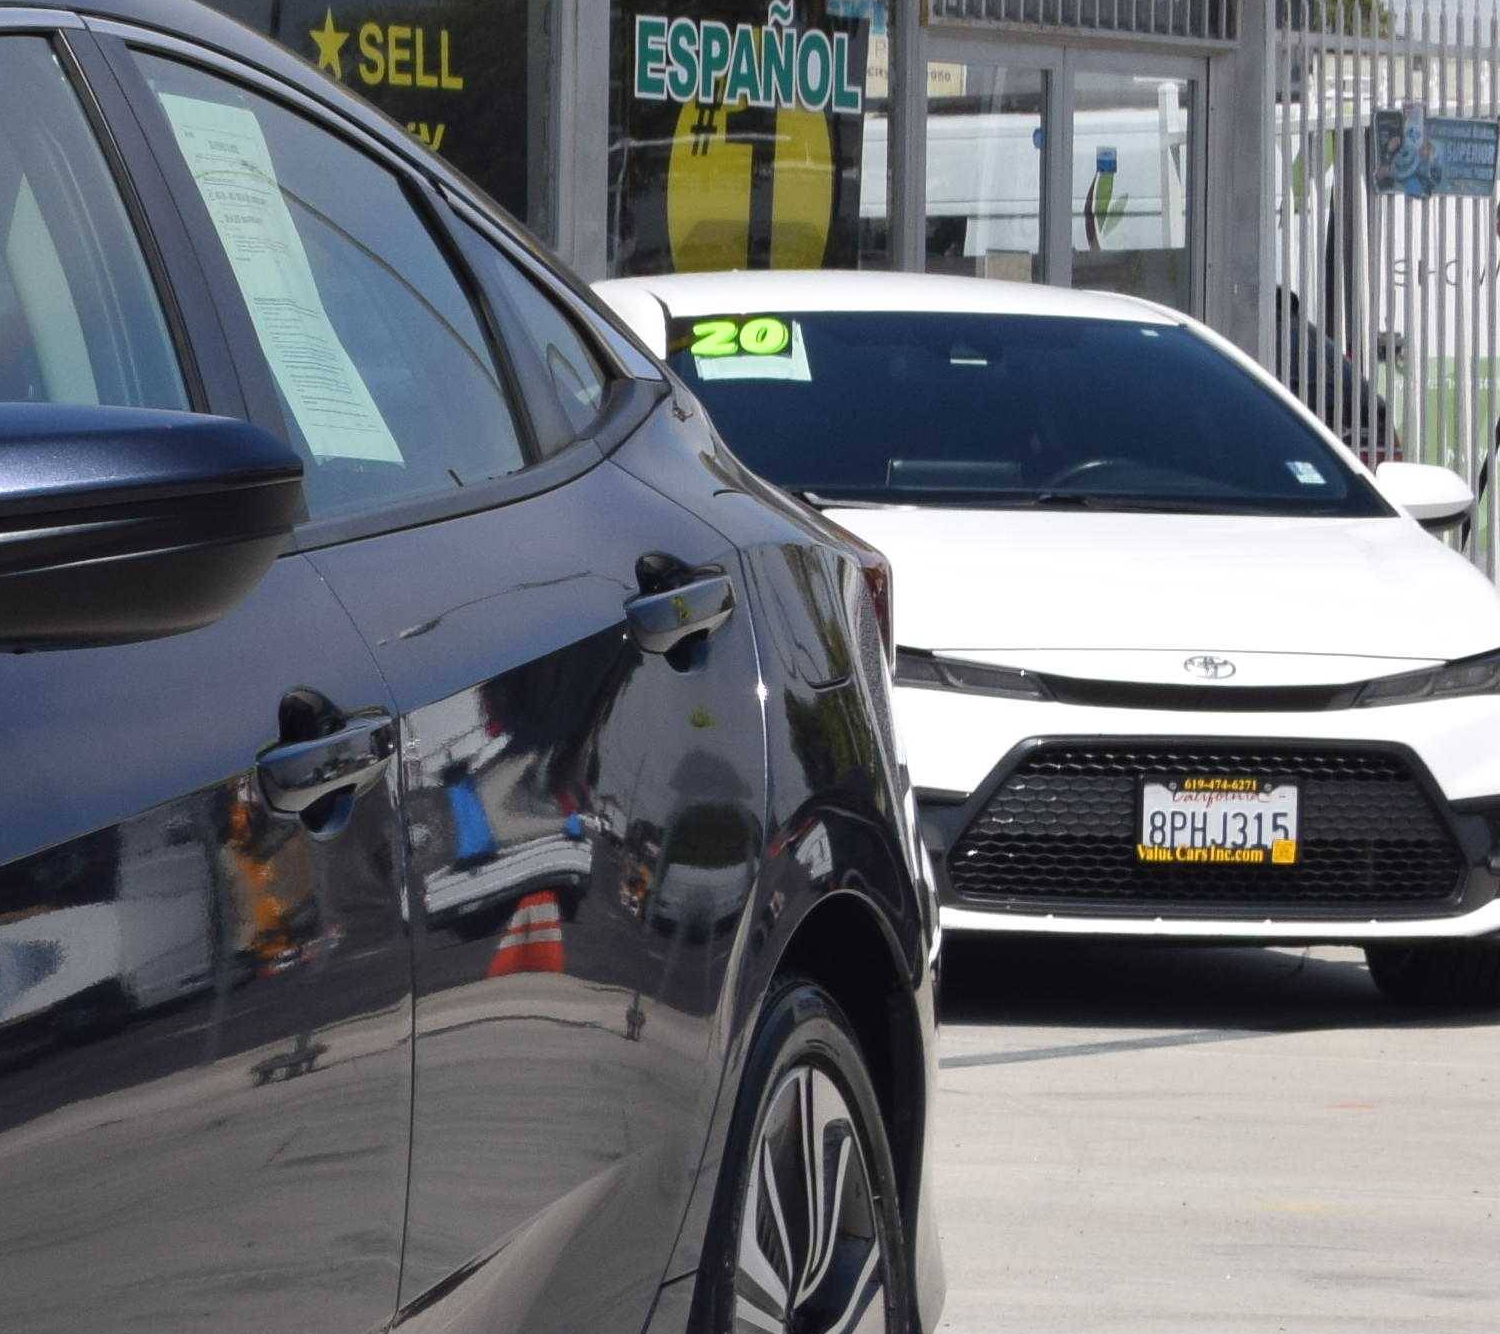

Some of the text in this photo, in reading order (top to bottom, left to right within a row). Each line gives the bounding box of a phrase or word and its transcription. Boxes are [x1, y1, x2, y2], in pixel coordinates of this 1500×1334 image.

[358, 22, 463, 90] SELL
[690, 318, 789, 357] 20
[1184, 779, 1257, 791] 619-474-6271
[1150, 811, 1289, 849] 8PHJ315
[1176, 845, 1207, 861] Cars
[1210, 845, 1264, 862] Inc.com
